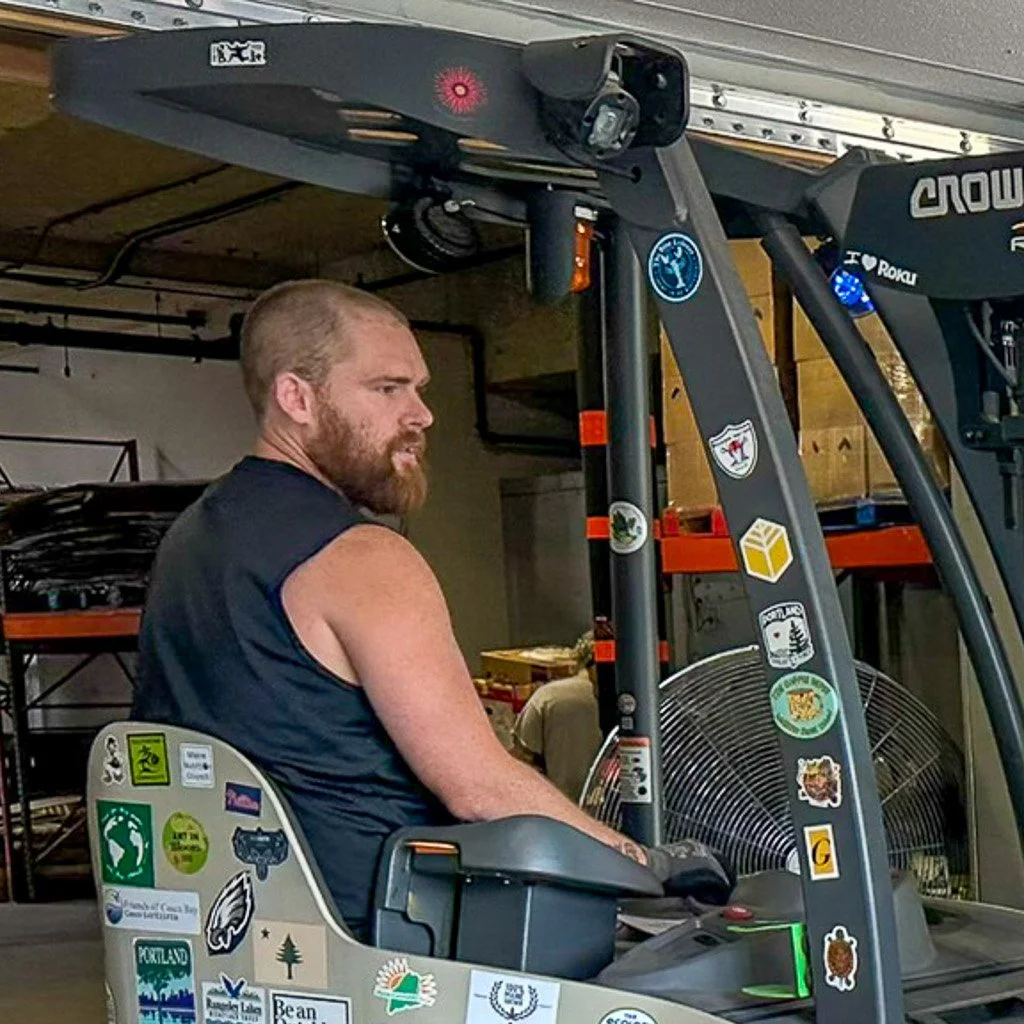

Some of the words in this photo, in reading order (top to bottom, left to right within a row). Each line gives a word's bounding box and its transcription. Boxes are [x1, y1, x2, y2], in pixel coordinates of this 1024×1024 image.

[138, 945, 188, 966] PORTLAND
[275, 998, 295, 1018] Be
[296, 1006, 316, 1019] an
